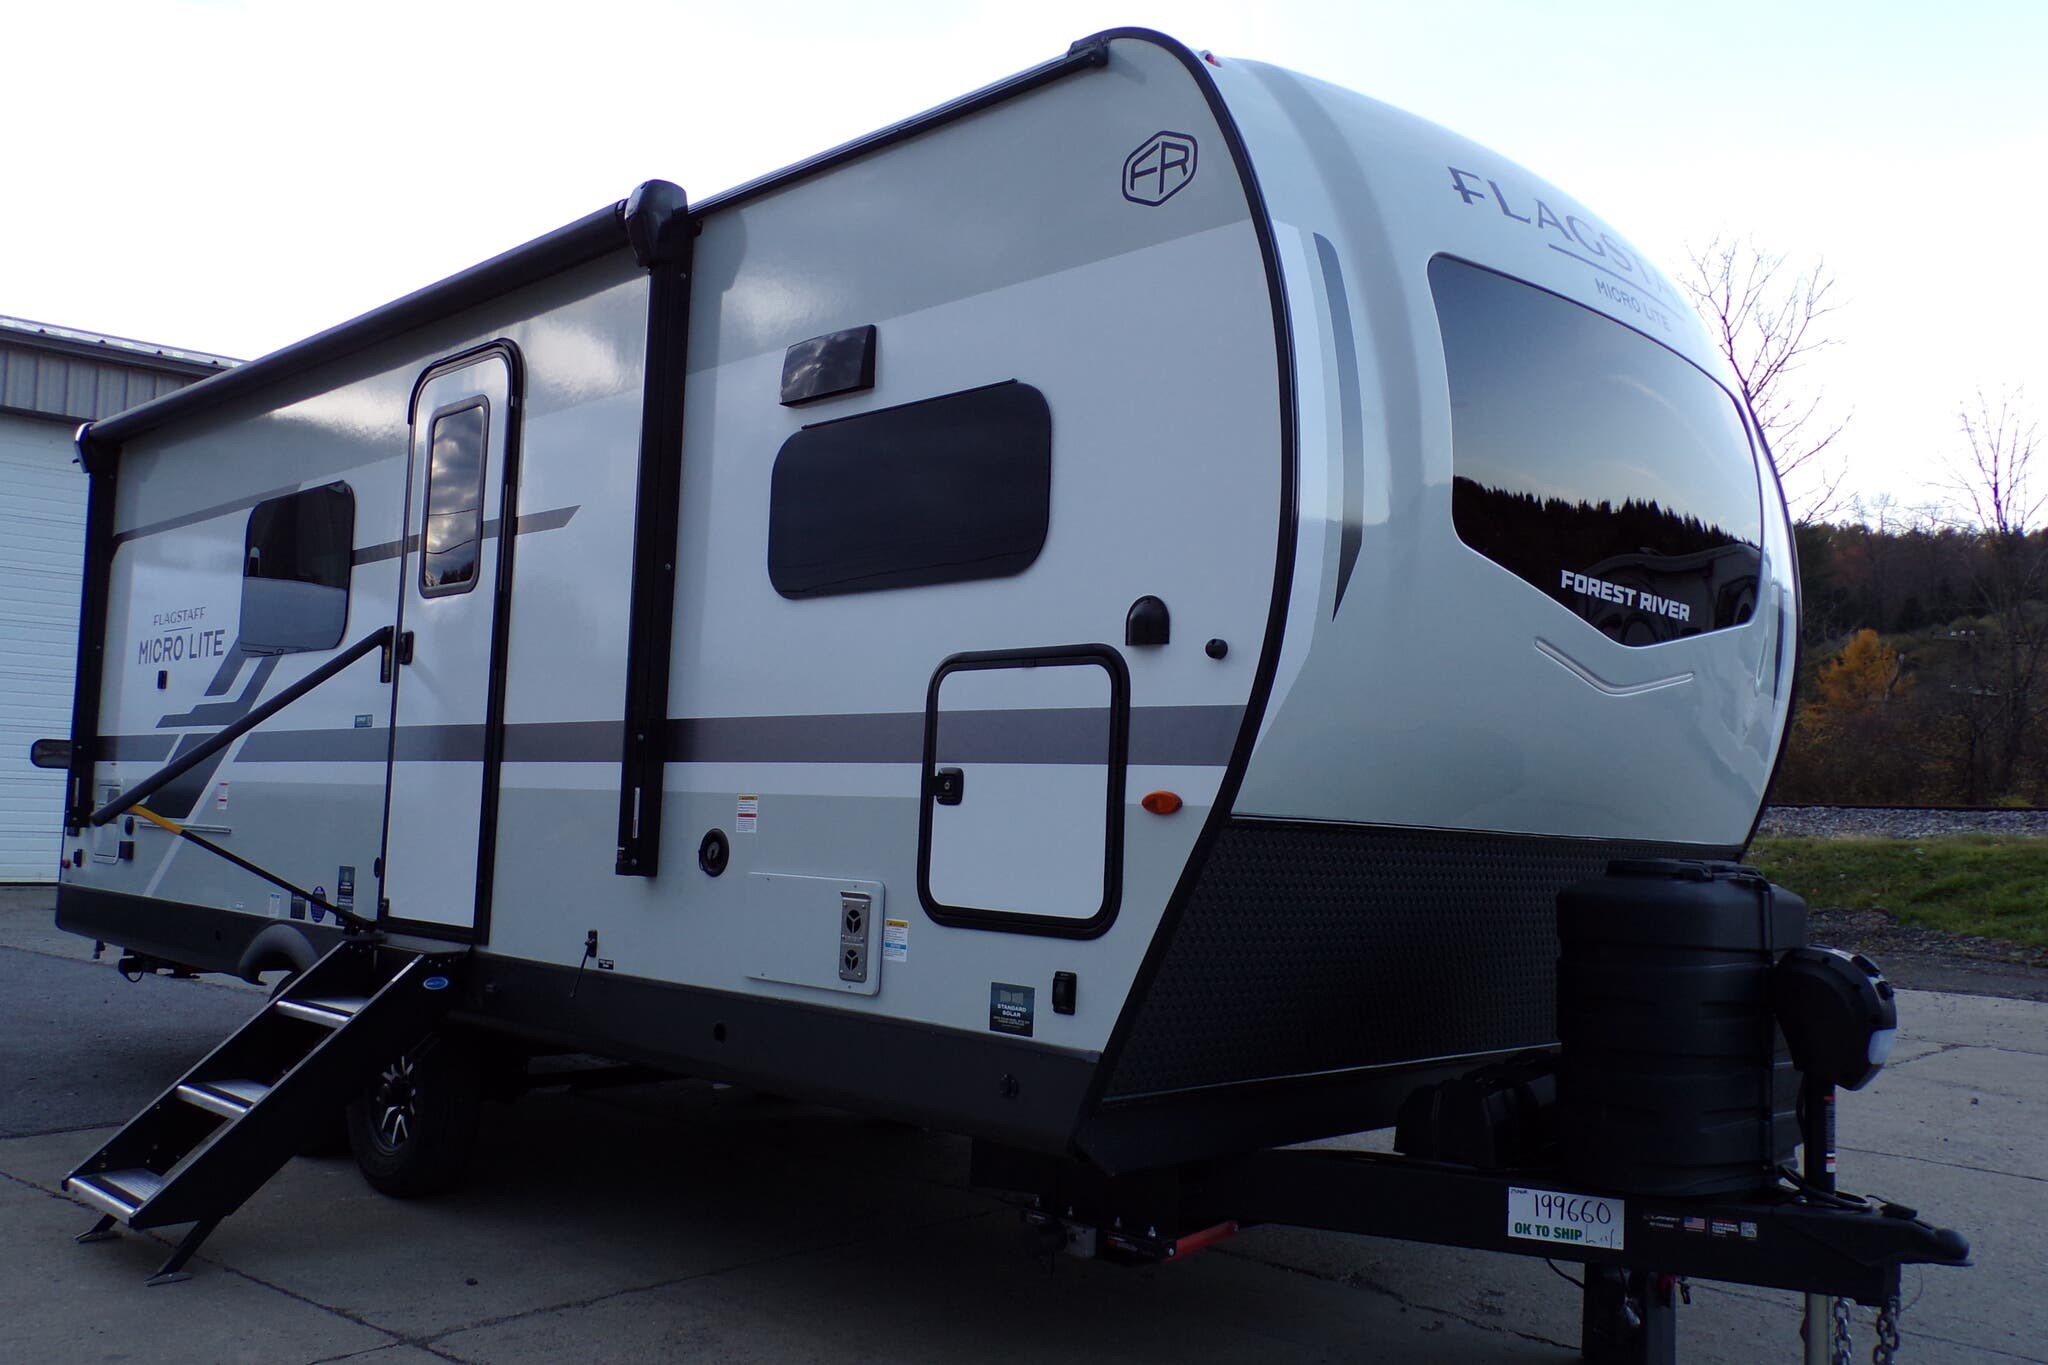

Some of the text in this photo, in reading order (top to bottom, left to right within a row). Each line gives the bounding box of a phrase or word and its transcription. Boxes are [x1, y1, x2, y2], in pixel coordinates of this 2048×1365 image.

[1130, 141, 1189, 195] FR
[1594, 277, 1672, 332] MICRO LITE
[1561, 569, 1690, 622] FOREST RIVER
[153, 606, 207, 627] FLAGSTAFF
[138, 629, 226, 665] MICRO LITE
[997, 1003, 1027, 1013] STANDARD
[1002, 1010, 1021, 1018] SOLAR
[1534, 1193, 1611, 1225] 199660
[1514, 1222, 1532, 1235] OK
[1535, 1224, 1550, 1238] TO
[1553, 1226, 1582, 1241] SHIP
